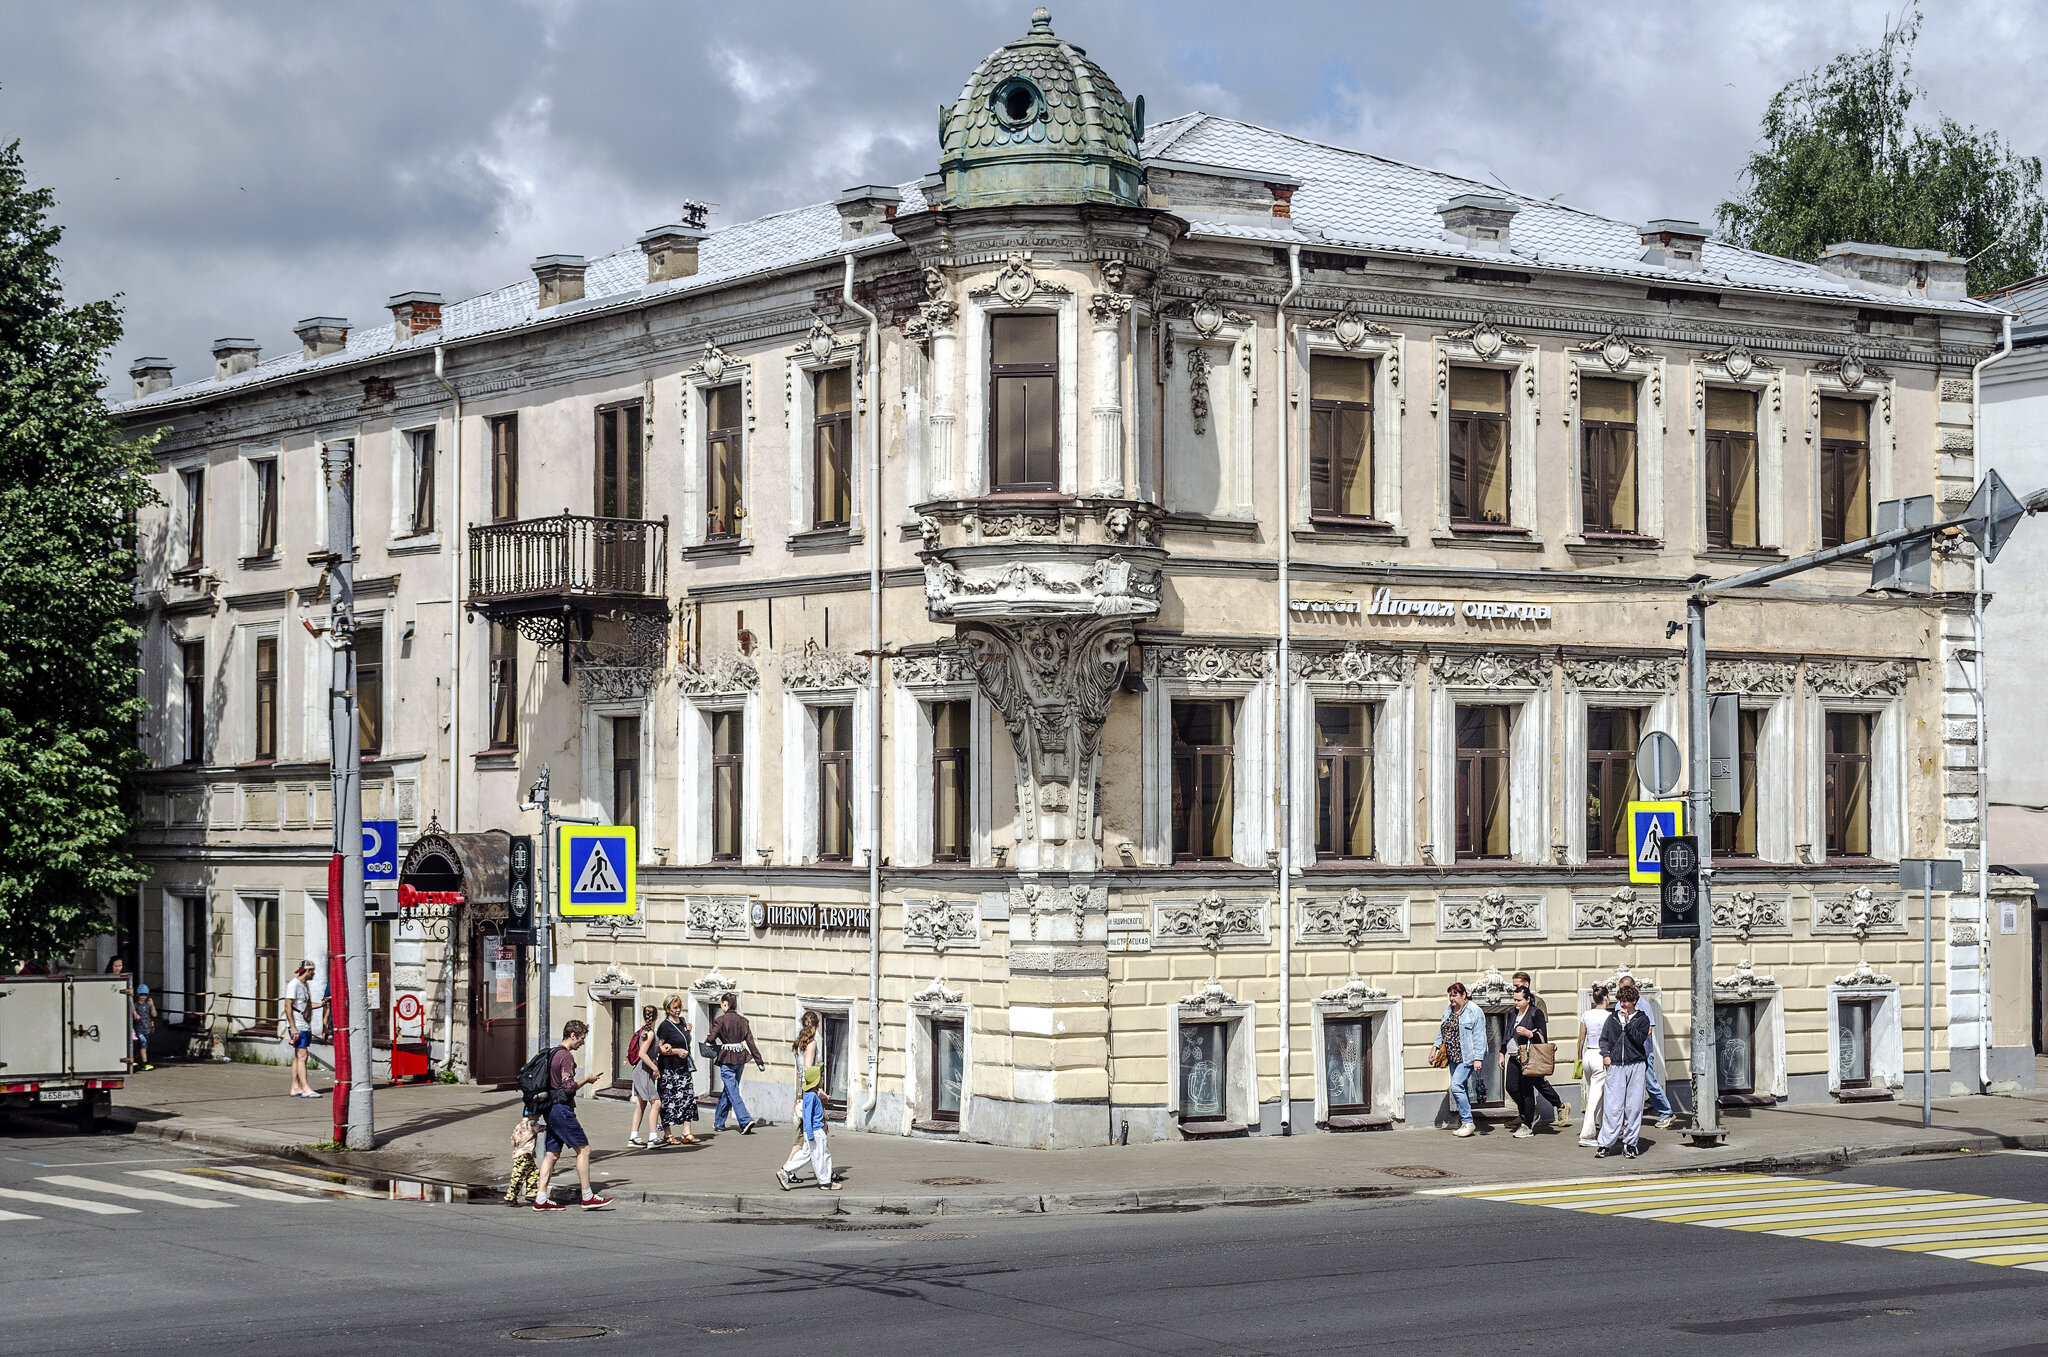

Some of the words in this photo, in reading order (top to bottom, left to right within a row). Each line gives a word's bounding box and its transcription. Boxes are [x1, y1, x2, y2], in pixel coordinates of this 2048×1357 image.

[1367, 587, 1455, 616] Лючия
[1461, 602, 1552, 620] ОДЕЖДЫ
[382, 863, 392, 871] 20
[767, 904, 816, 926] ПИВНОЙ
[819, 907, 870, 930] ДВОРИК
[1113, 917, 1143, 925] УШИНСКОГО
